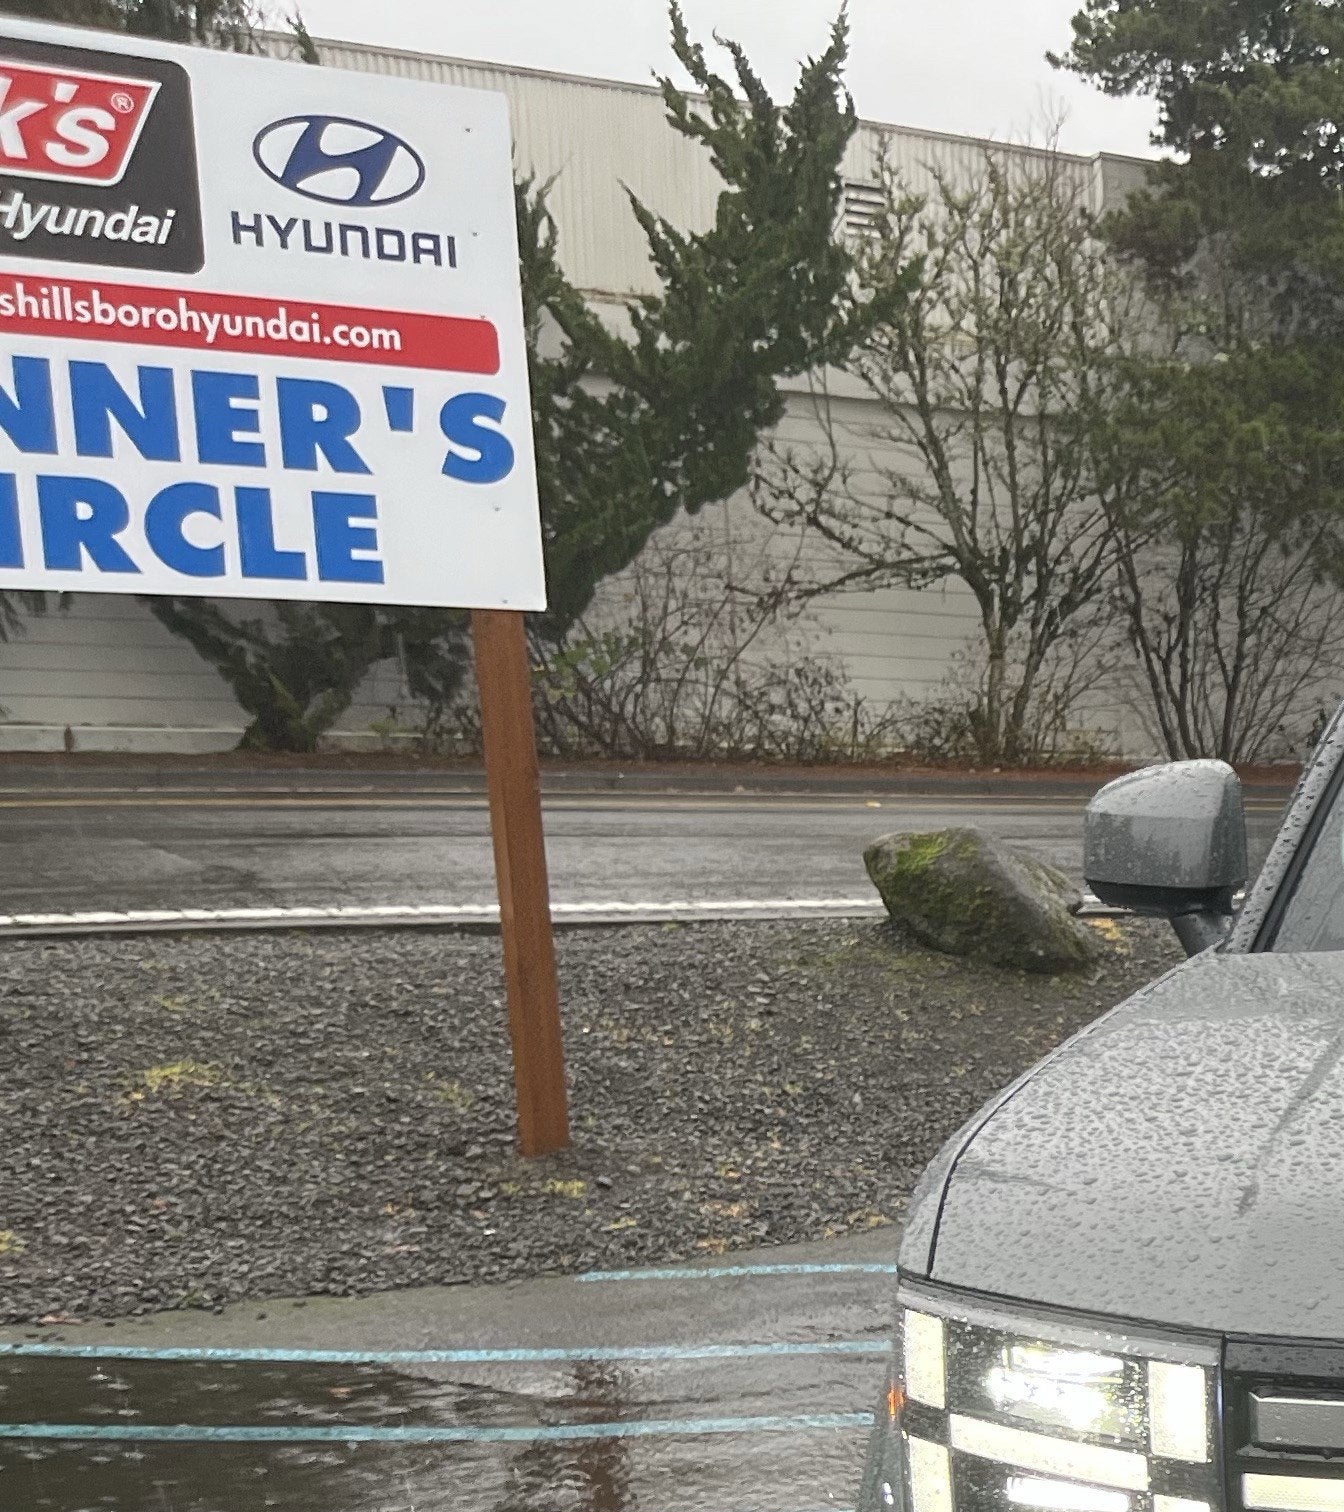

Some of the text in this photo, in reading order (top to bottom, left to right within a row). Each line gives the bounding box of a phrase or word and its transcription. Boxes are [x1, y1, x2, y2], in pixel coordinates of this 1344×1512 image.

[0, 192, 176, 245] Hyundai
[231, 211, 458, 268] HYUNDAI
[0, 282, 402, 350] shillsborohyundai.com
